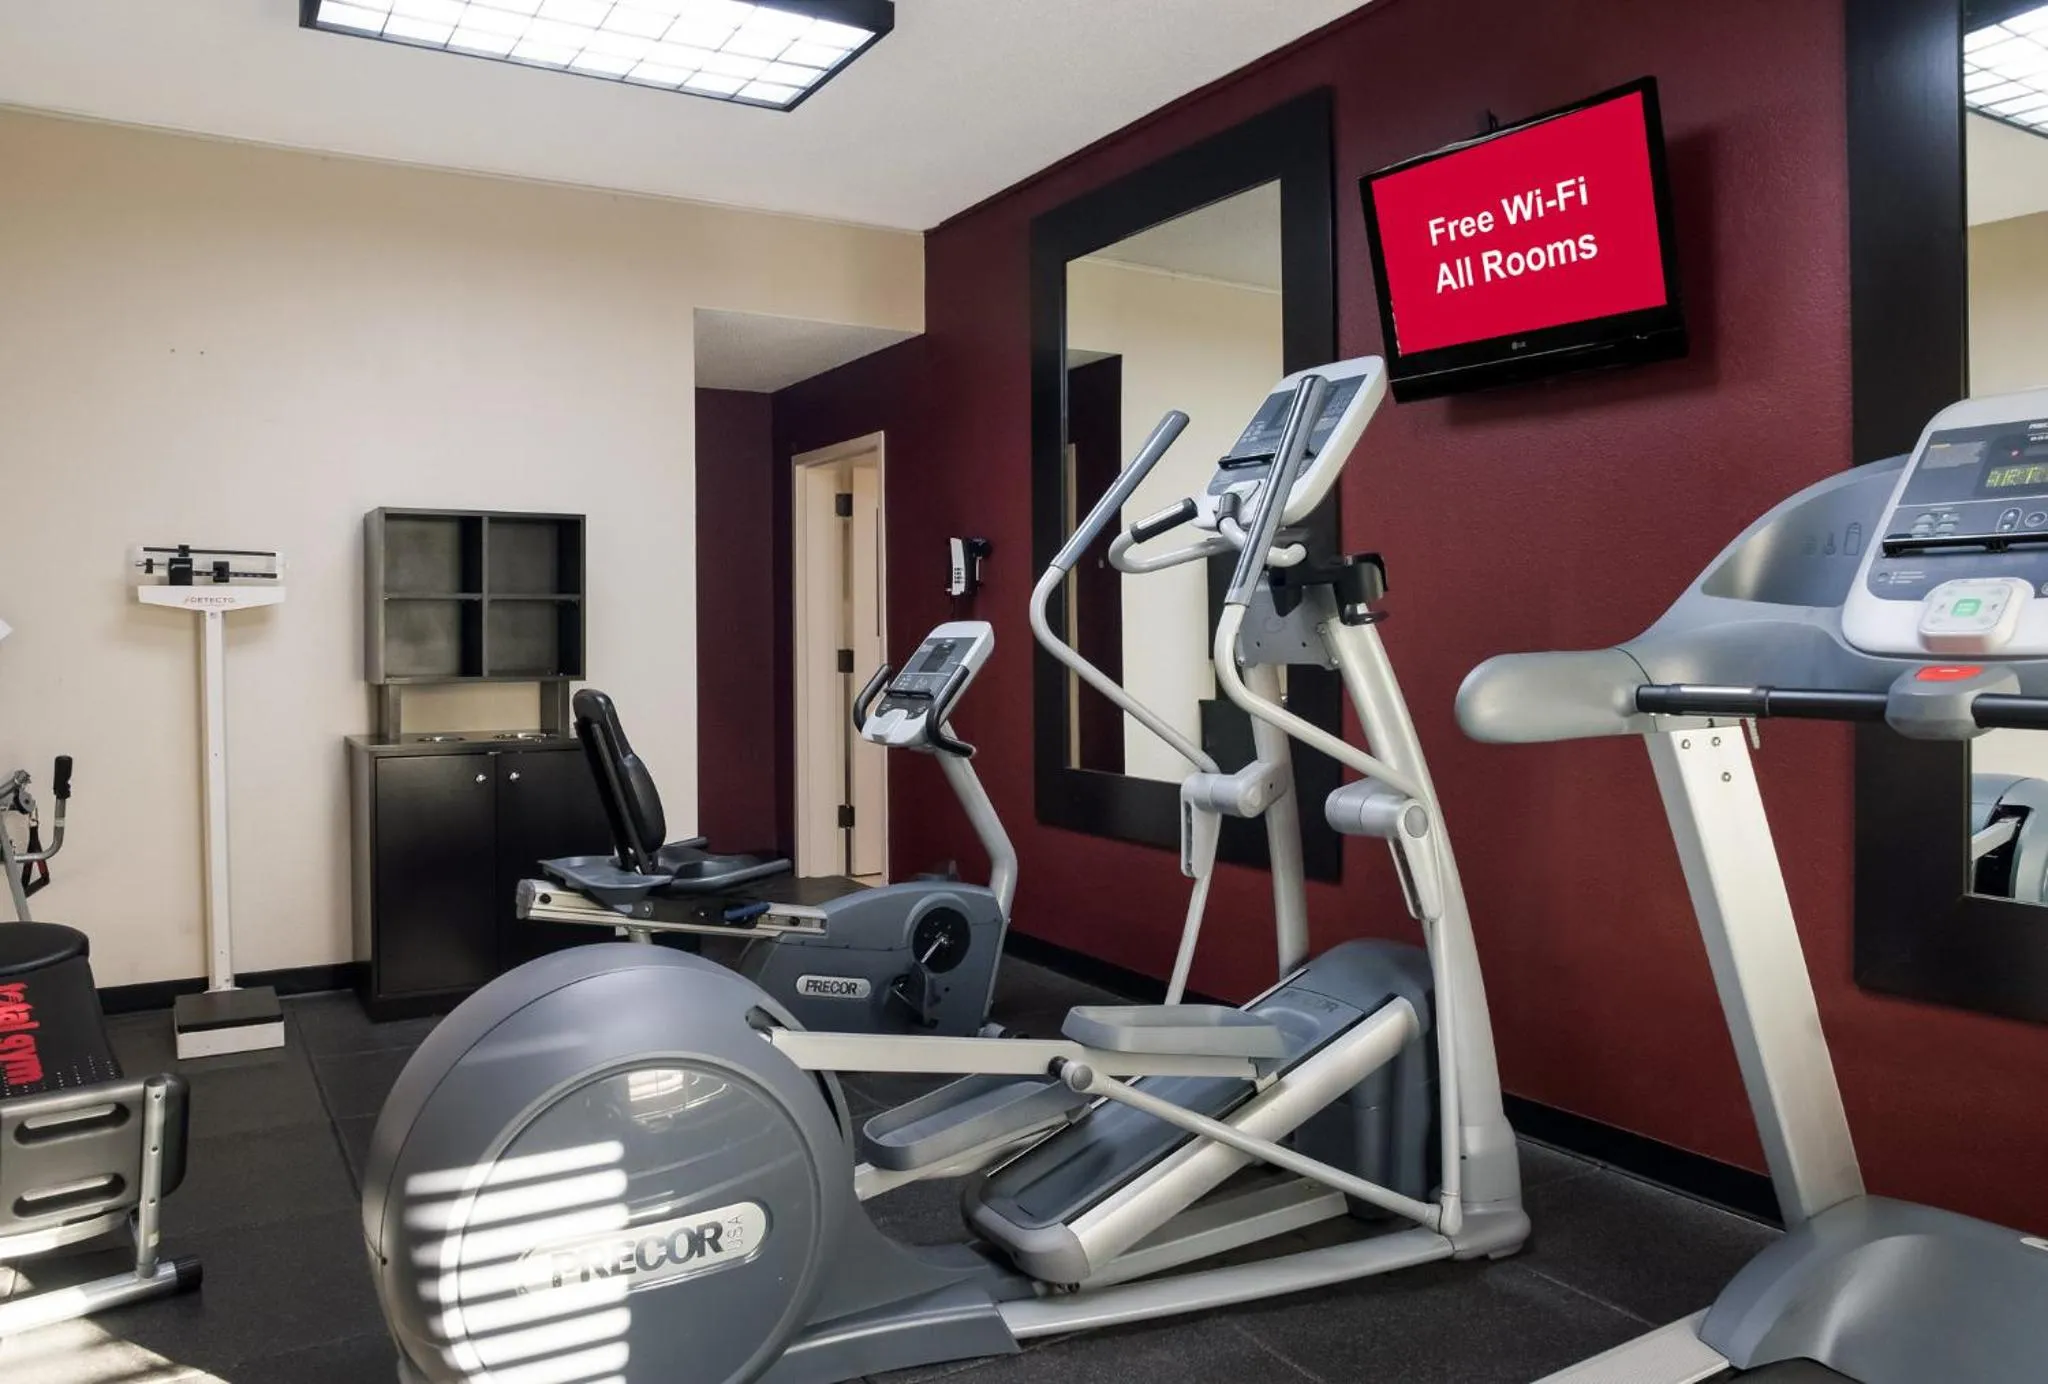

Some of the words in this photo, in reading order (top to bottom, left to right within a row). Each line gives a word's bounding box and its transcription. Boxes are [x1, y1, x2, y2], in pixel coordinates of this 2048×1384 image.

[1428, 210, 1495, 246] Free
[1501, 176, 1588, 225] Wi-Fi
[1436, 256, 1474, 294] All
[1481, 233, 1598, 282] Rooms
[806, 980, 858, 994] PRECOR
[550, 1221, 725, 1288] PRECOR
